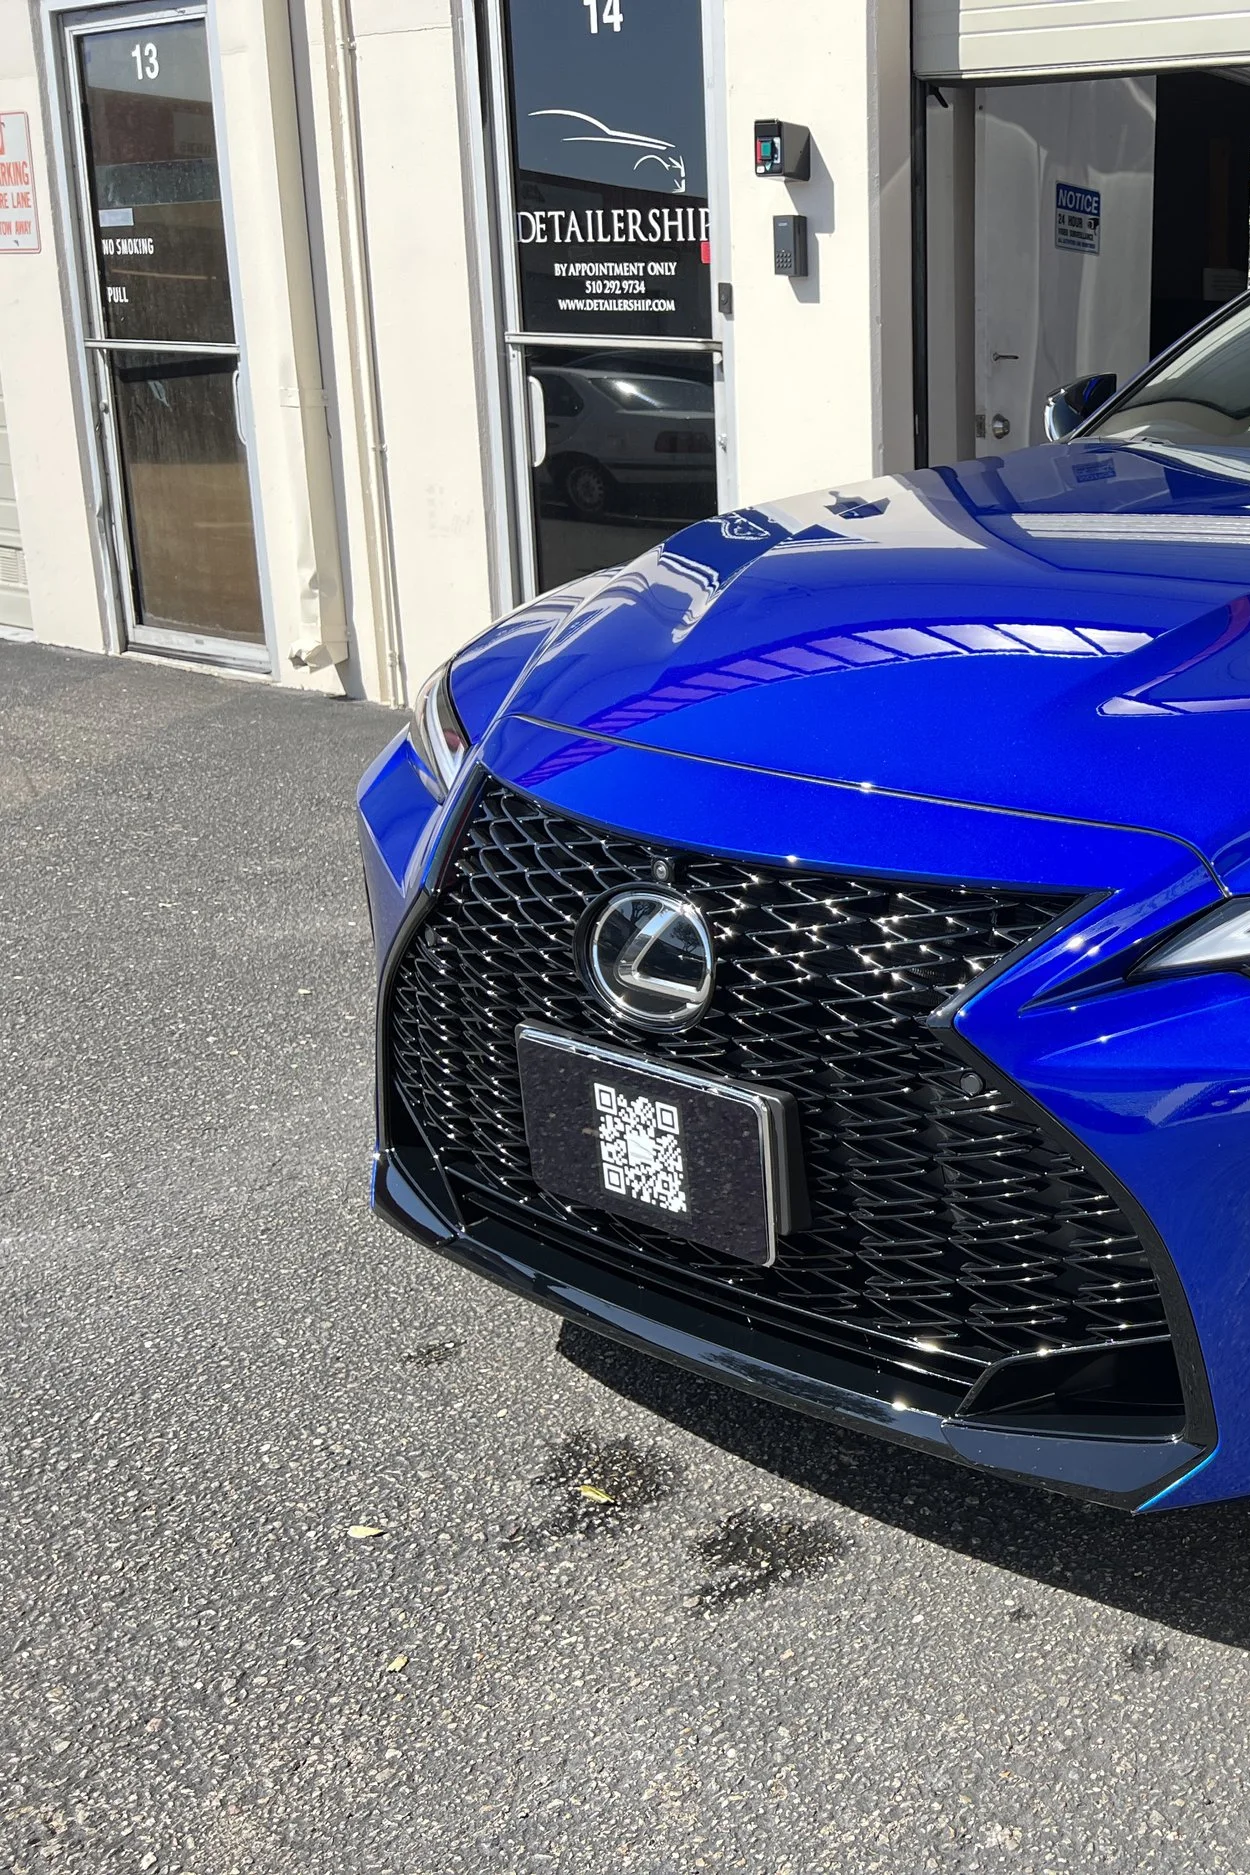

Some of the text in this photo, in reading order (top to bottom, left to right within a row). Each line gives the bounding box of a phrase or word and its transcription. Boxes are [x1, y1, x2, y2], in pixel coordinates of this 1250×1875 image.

[583, 0, 624, 34] 14
[131, 42, 160, 80] 13
[0, 161, 29, 186] RKING
[11, 191, 31, 208] LANE
[1058, 189, 1099, 214] NOTICE
[15, 220, 31, 235] AWAY
[518, 208, 711, 243] DETAILERSHIP
[1058, 213, 1083, 229] 24 HOUR
[102, 238, 154, 255] NO SMOKING
[554, 262, 677, 277] BY APPOINTMENT ONLY
[106, 286, 129, 303] PULL
[585, 280, 646, 294] 510 292 9734
[558, 299, 676, 312] WWW.DETAILERSHIP.COM
